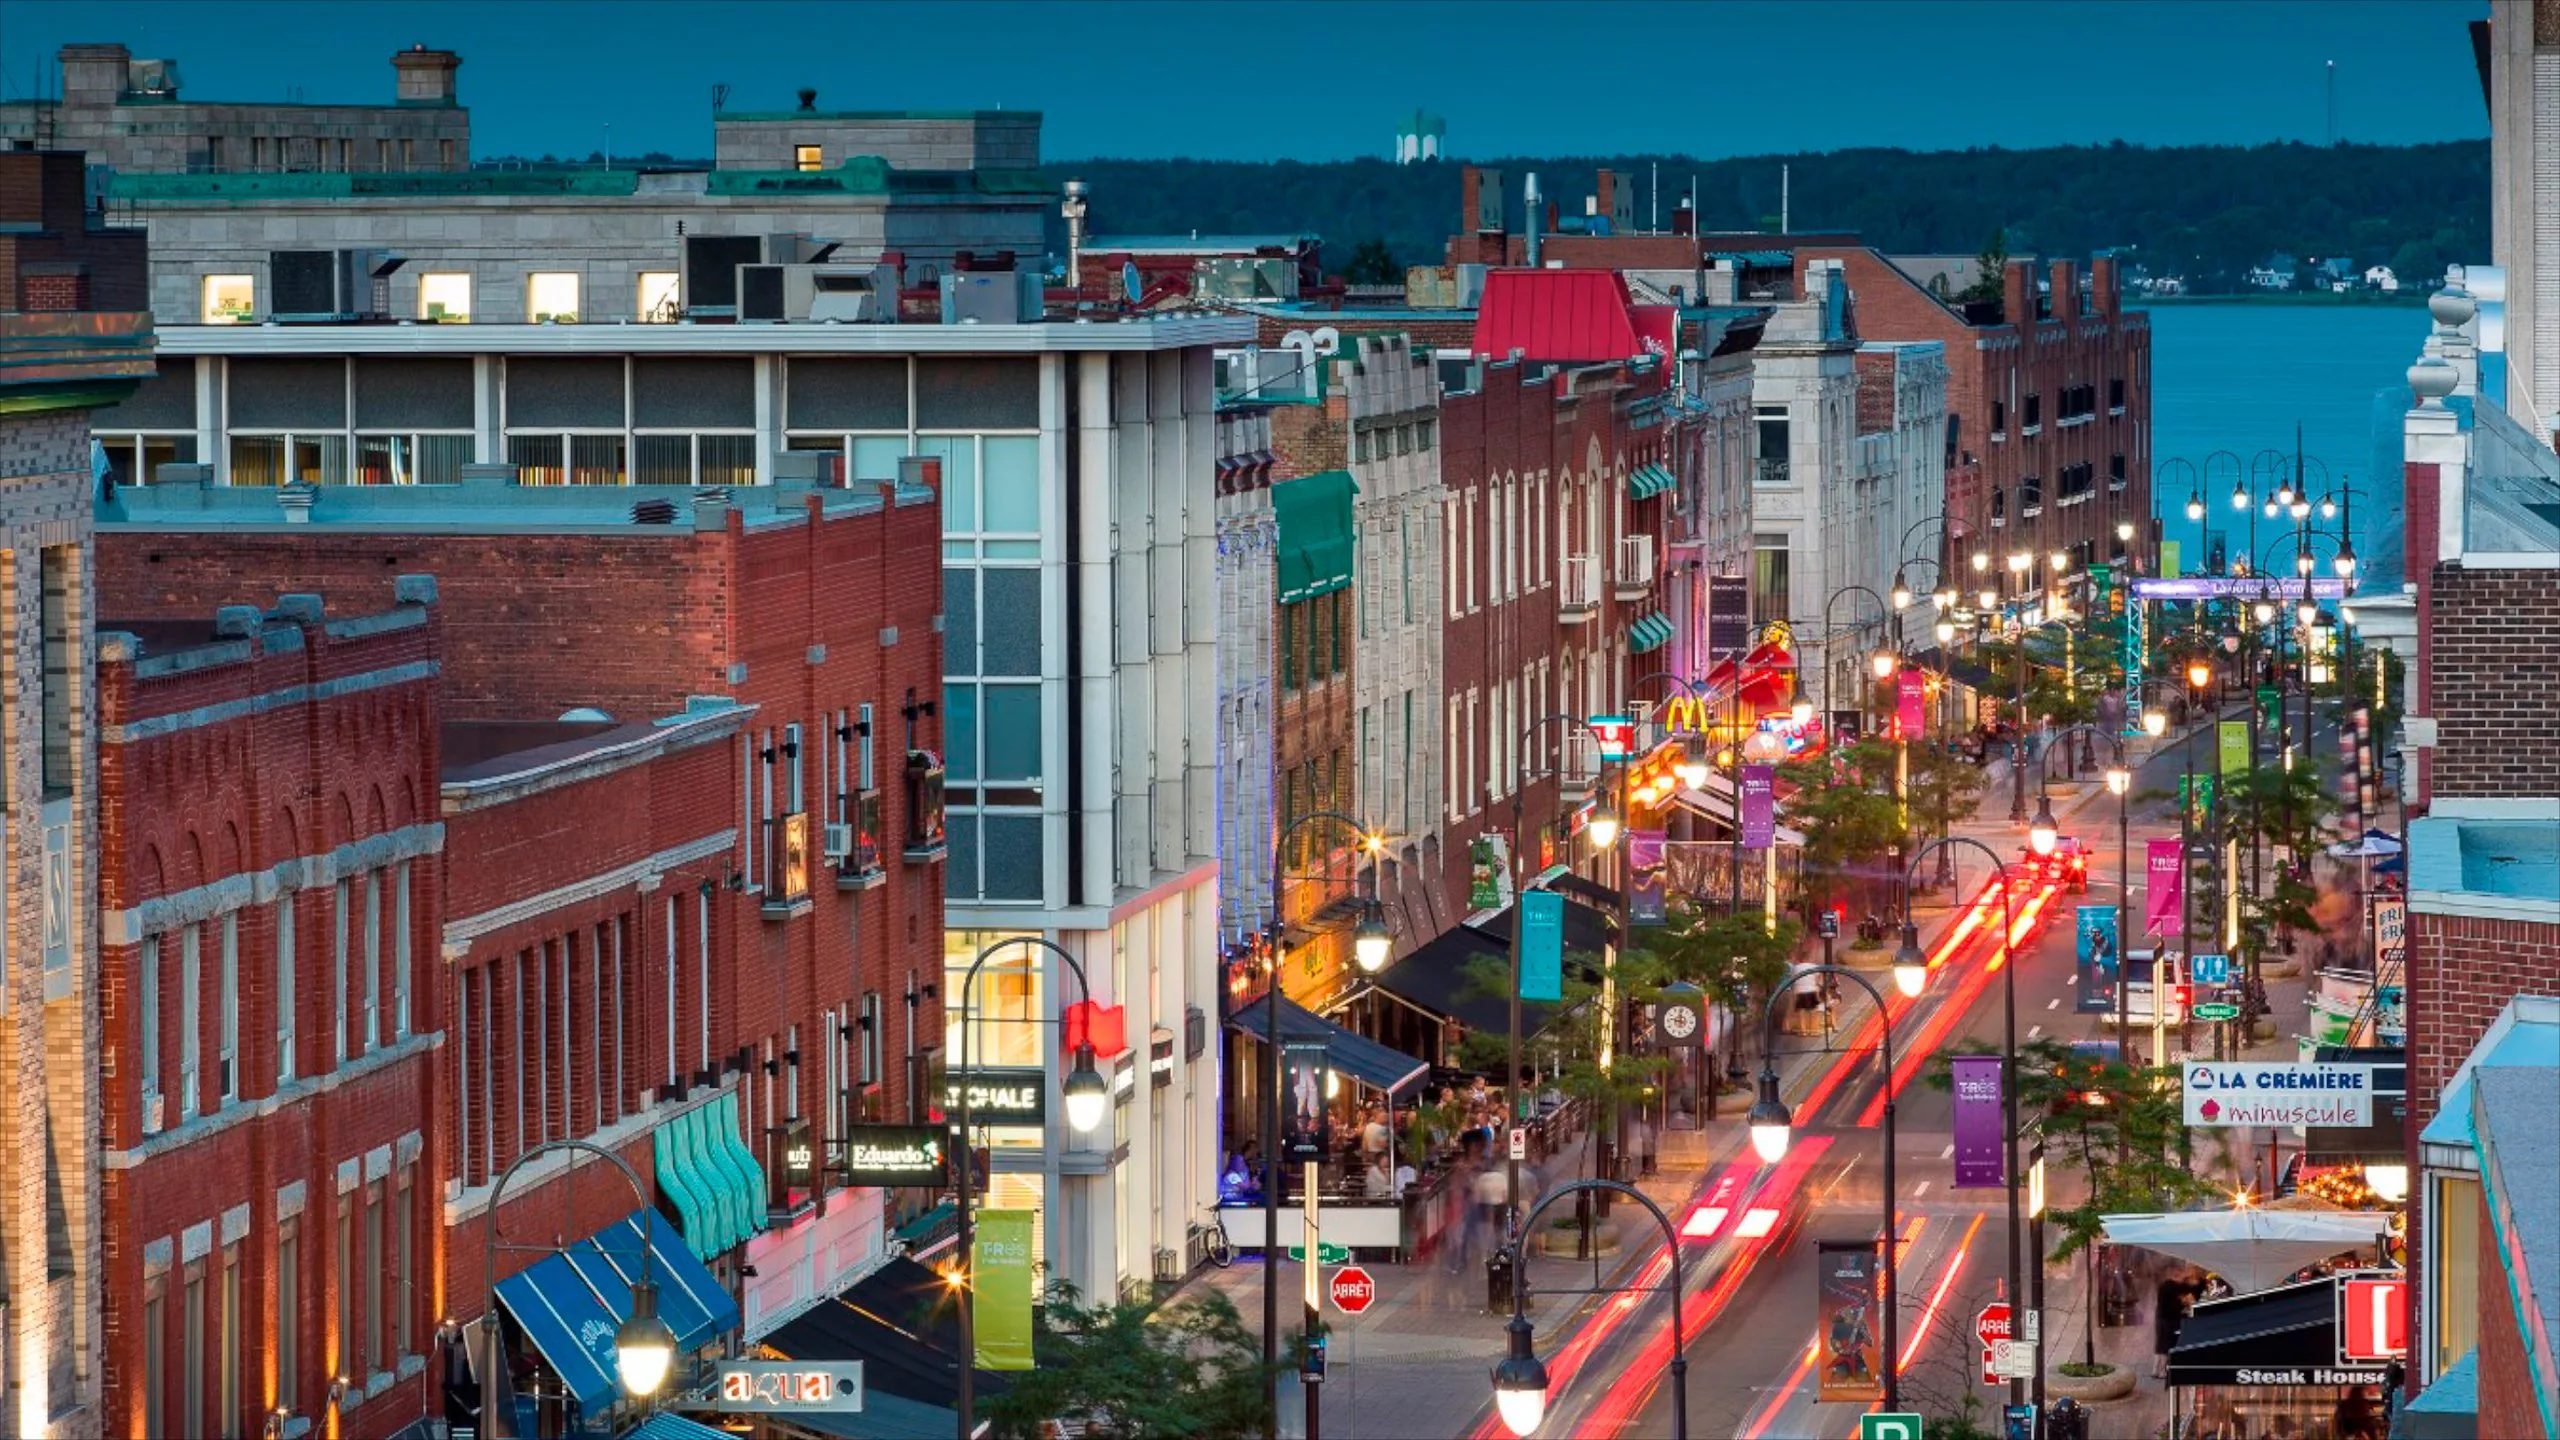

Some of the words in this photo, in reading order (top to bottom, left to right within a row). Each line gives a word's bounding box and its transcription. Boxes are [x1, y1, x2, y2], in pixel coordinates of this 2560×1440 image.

[2220, 1073, 2246, 1089] LA
[2229, 1097, 2358, 1123] minuscule
[853, 1145, 924, 1164] Eduardo
[1334, 1280, 1371, 1298] ARRÊT
[2236, 1369, 2306, 1384] Steak
